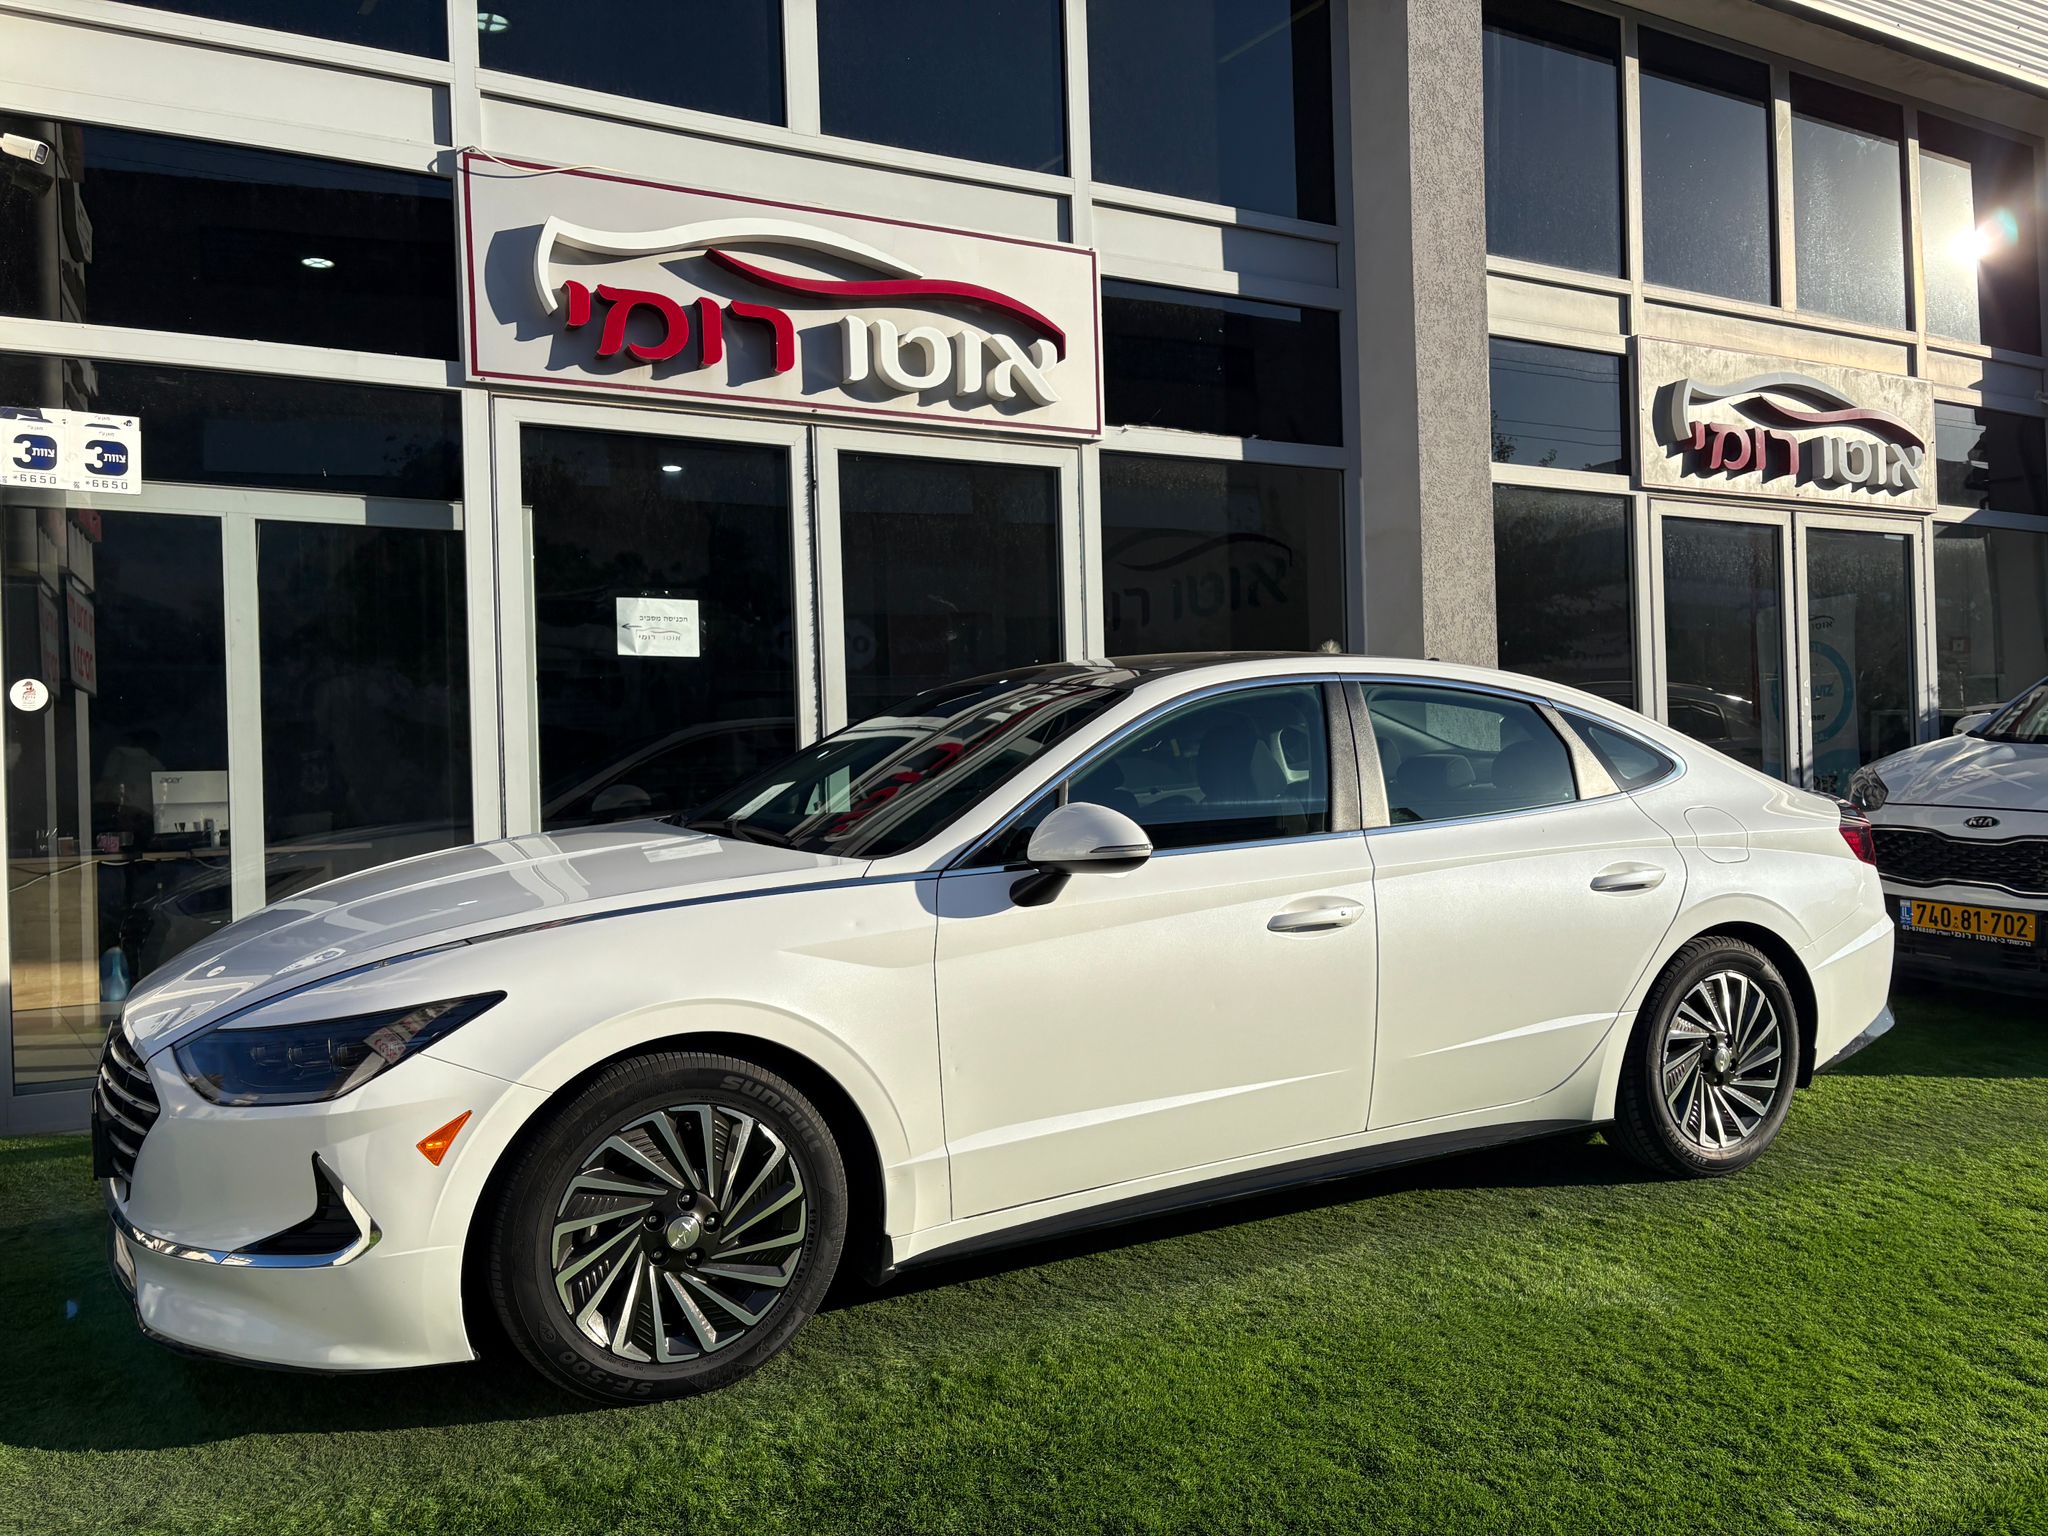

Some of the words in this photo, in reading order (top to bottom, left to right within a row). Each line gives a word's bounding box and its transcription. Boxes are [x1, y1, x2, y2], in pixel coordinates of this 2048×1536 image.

[561, 279, 796, 374] רומי
[838, 314, 1062, 407] אוטו
[1692, 420, 1799, 475] רומי
[1815, 435, 1924, 489] אוטו
[1968, 817, 1993, 827] KIA
[719, 1074, 823, 1153] SUNFULL
[558, 1351, 654, 1396] SF-500
